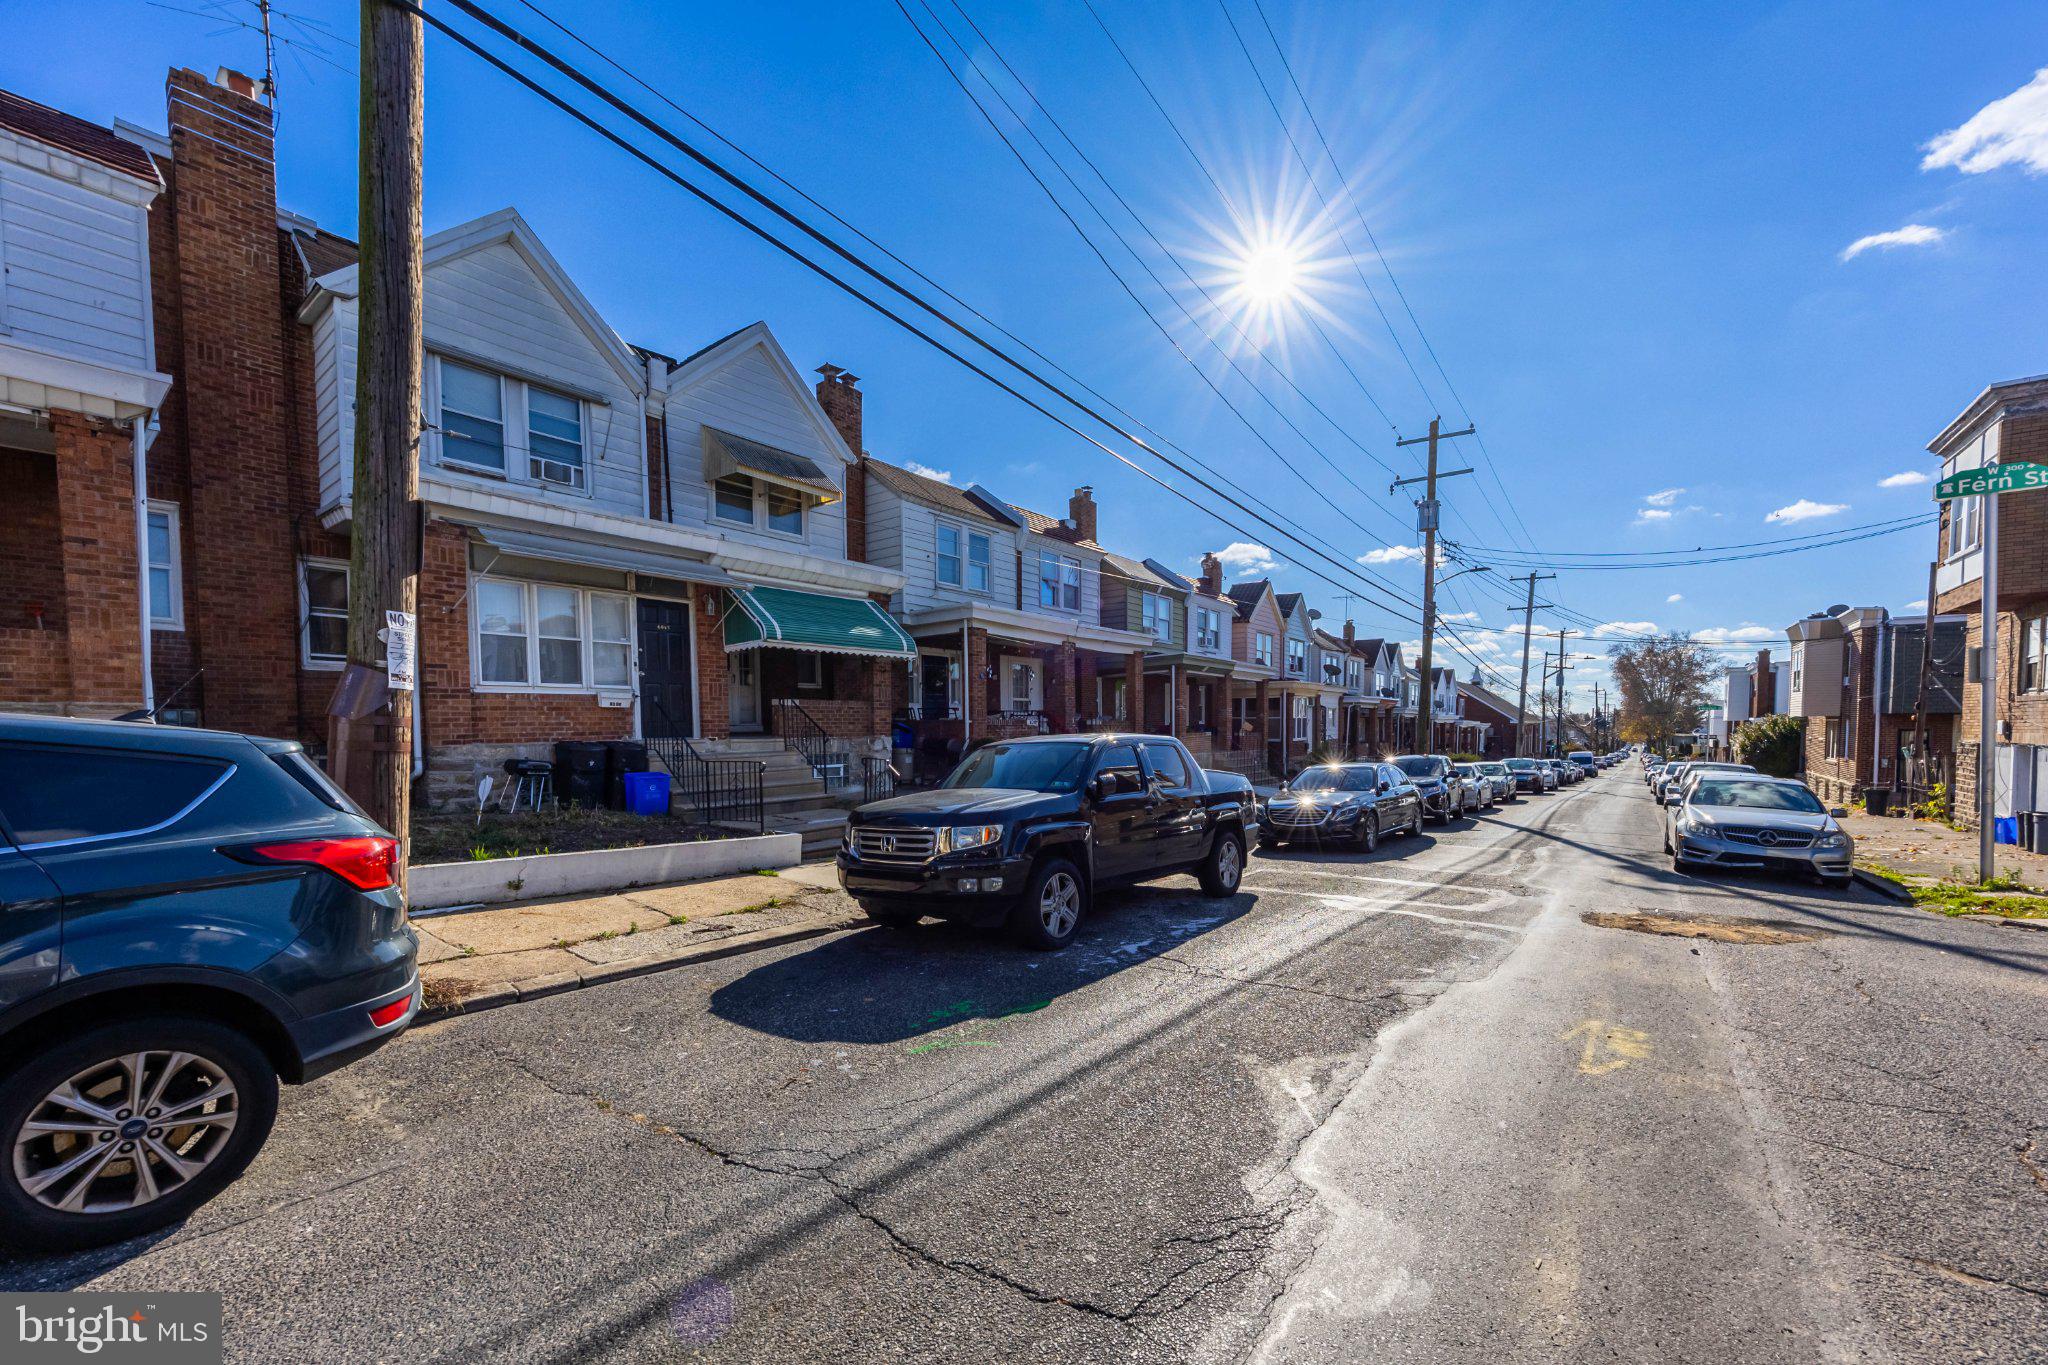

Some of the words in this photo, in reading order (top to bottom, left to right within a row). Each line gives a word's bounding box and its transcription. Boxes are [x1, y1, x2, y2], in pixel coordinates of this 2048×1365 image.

[1987, 467, 1999, 475] W
[2005, 464, 2025, 472] 300
[1958, 475, 2012, 494] Fern
[2024, 470, 2048, 485] St
[389, 612, 404, 627] NO
